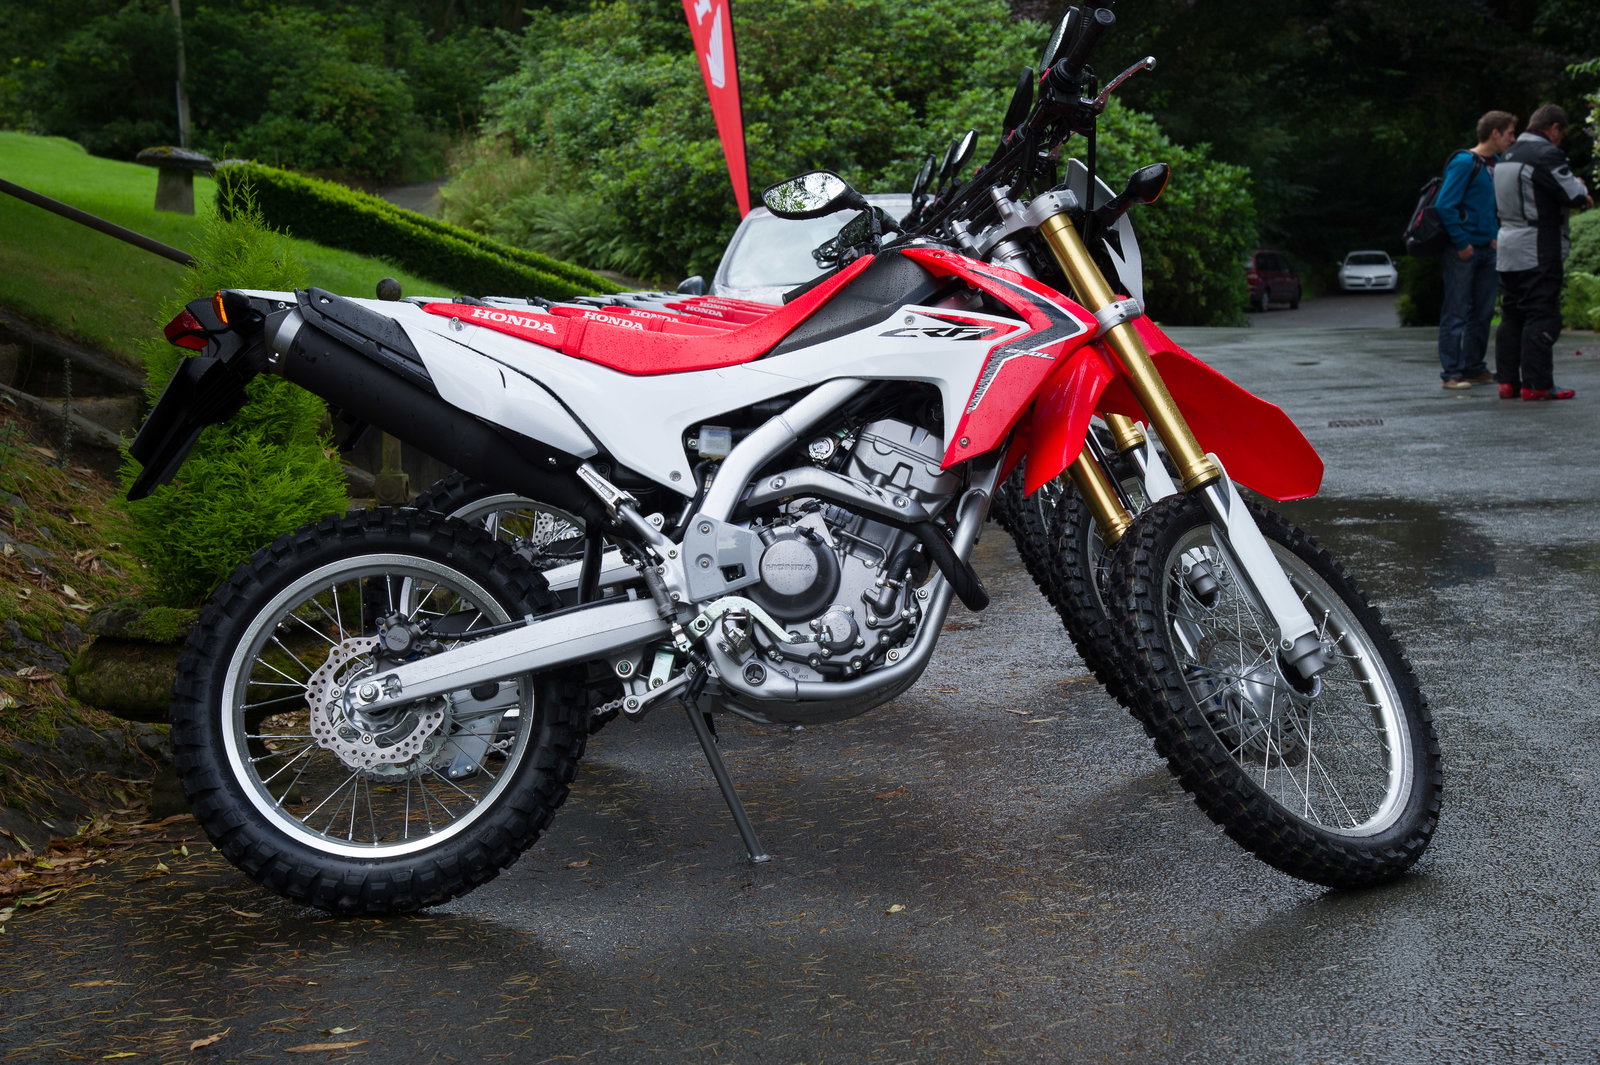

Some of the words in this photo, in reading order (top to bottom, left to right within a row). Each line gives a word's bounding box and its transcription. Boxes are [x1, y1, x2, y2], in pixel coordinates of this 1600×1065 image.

[685, 305, 723, 318] HONDA
[471, 308, 556, 335] HONDA
[582, 311, 644, 331] HONDA
[878, 326, 998, 341] CRF
